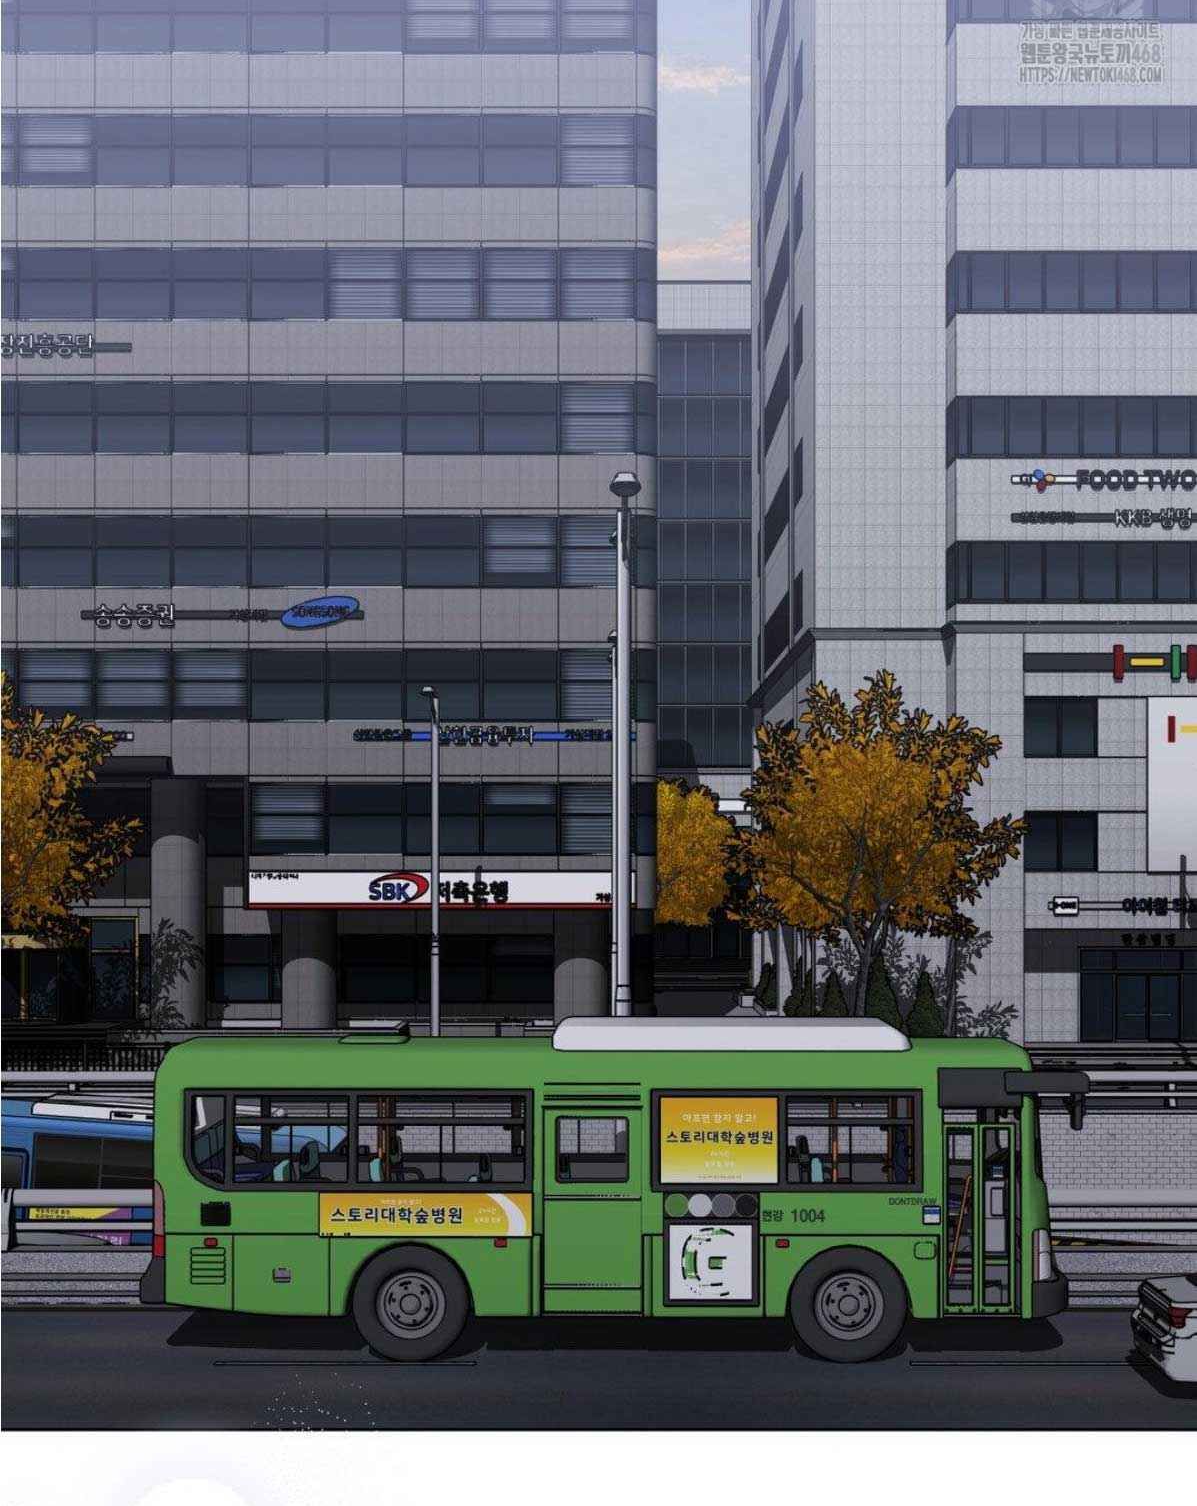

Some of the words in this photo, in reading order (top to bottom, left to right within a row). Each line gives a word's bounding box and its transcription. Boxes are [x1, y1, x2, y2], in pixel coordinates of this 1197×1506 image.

[1076, 469, 1138, 491] FOOD
[1114, 508, 1153, 528] KKB
[96, 603, 175, 629] 송송증권
[368, 881, 411, 902] SBK
[666, 1130, 774, 1146] 스토리대학숲병원
[330, 1206, 463, 1224] 스토리대학숲병원
[790, 1209, 826, 1223] 1004
